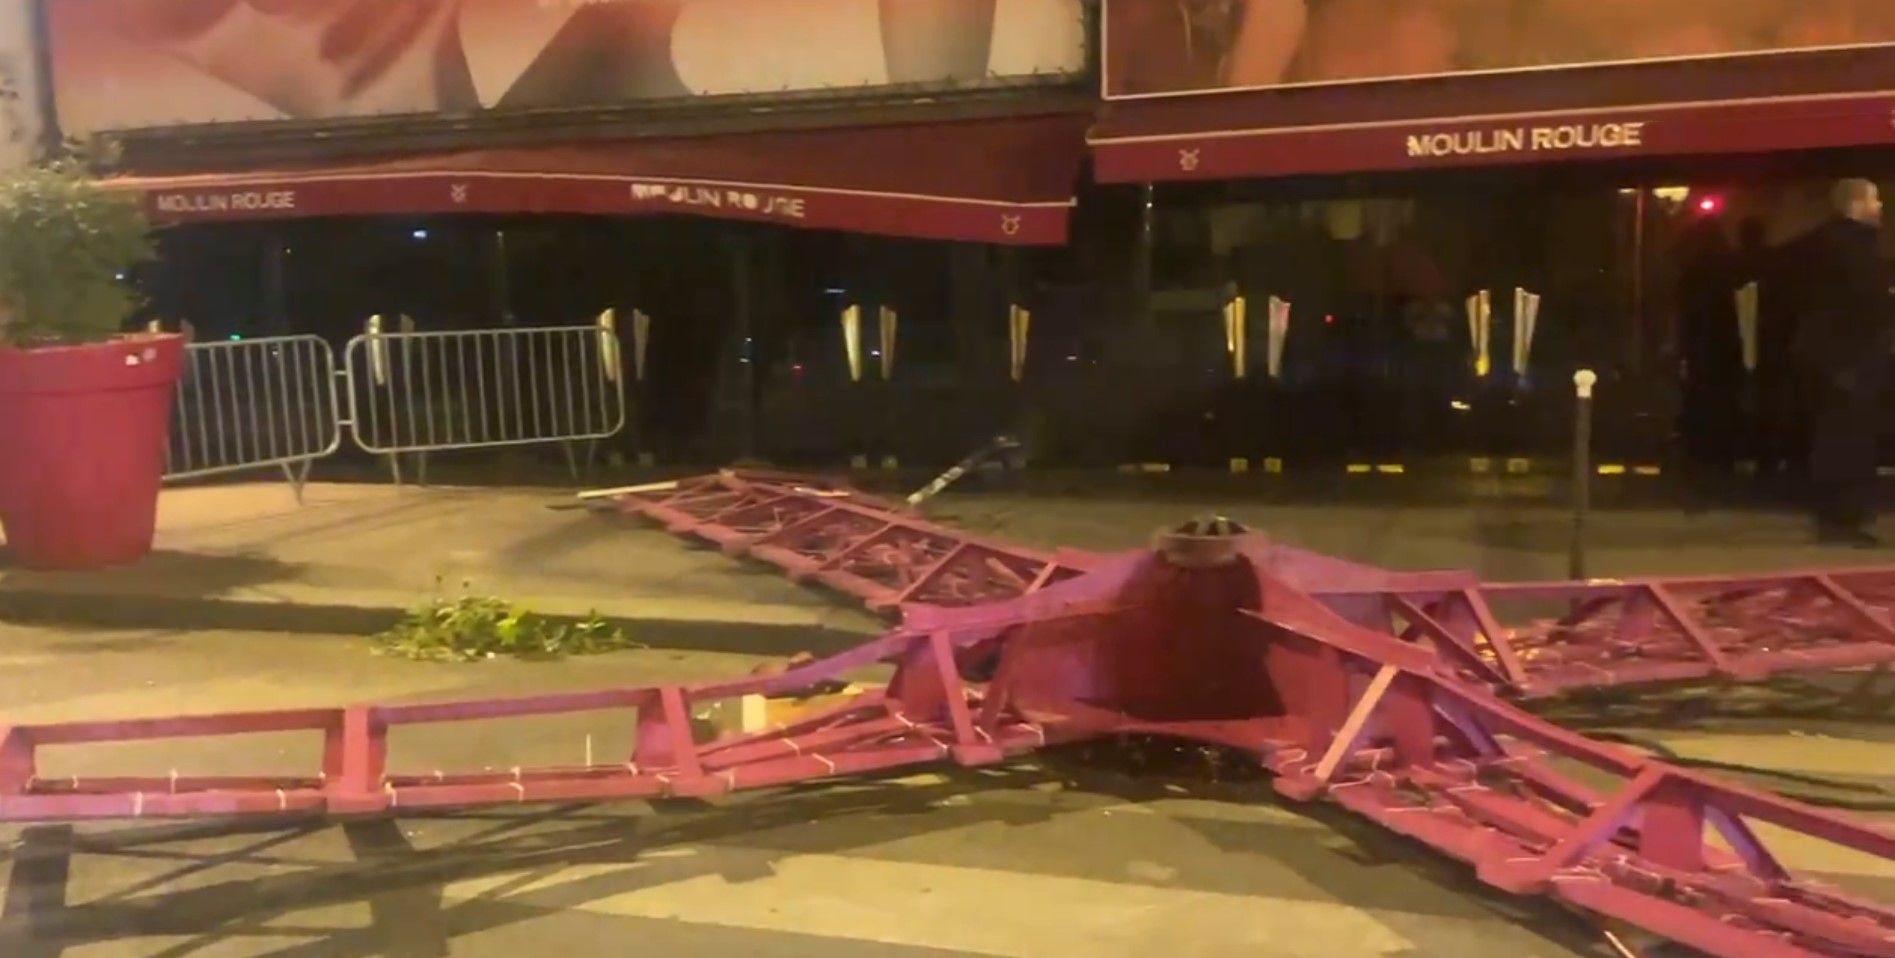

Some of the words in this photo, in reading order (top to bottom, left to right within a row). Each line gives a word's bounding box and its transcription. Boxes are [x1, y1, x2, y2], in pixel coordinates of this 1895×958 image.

[1407, 128, 1523, 156] MOULIN
[1531, 122, 1644, 150] ROUGE
[231, 191, 296, 209] ROUGE
